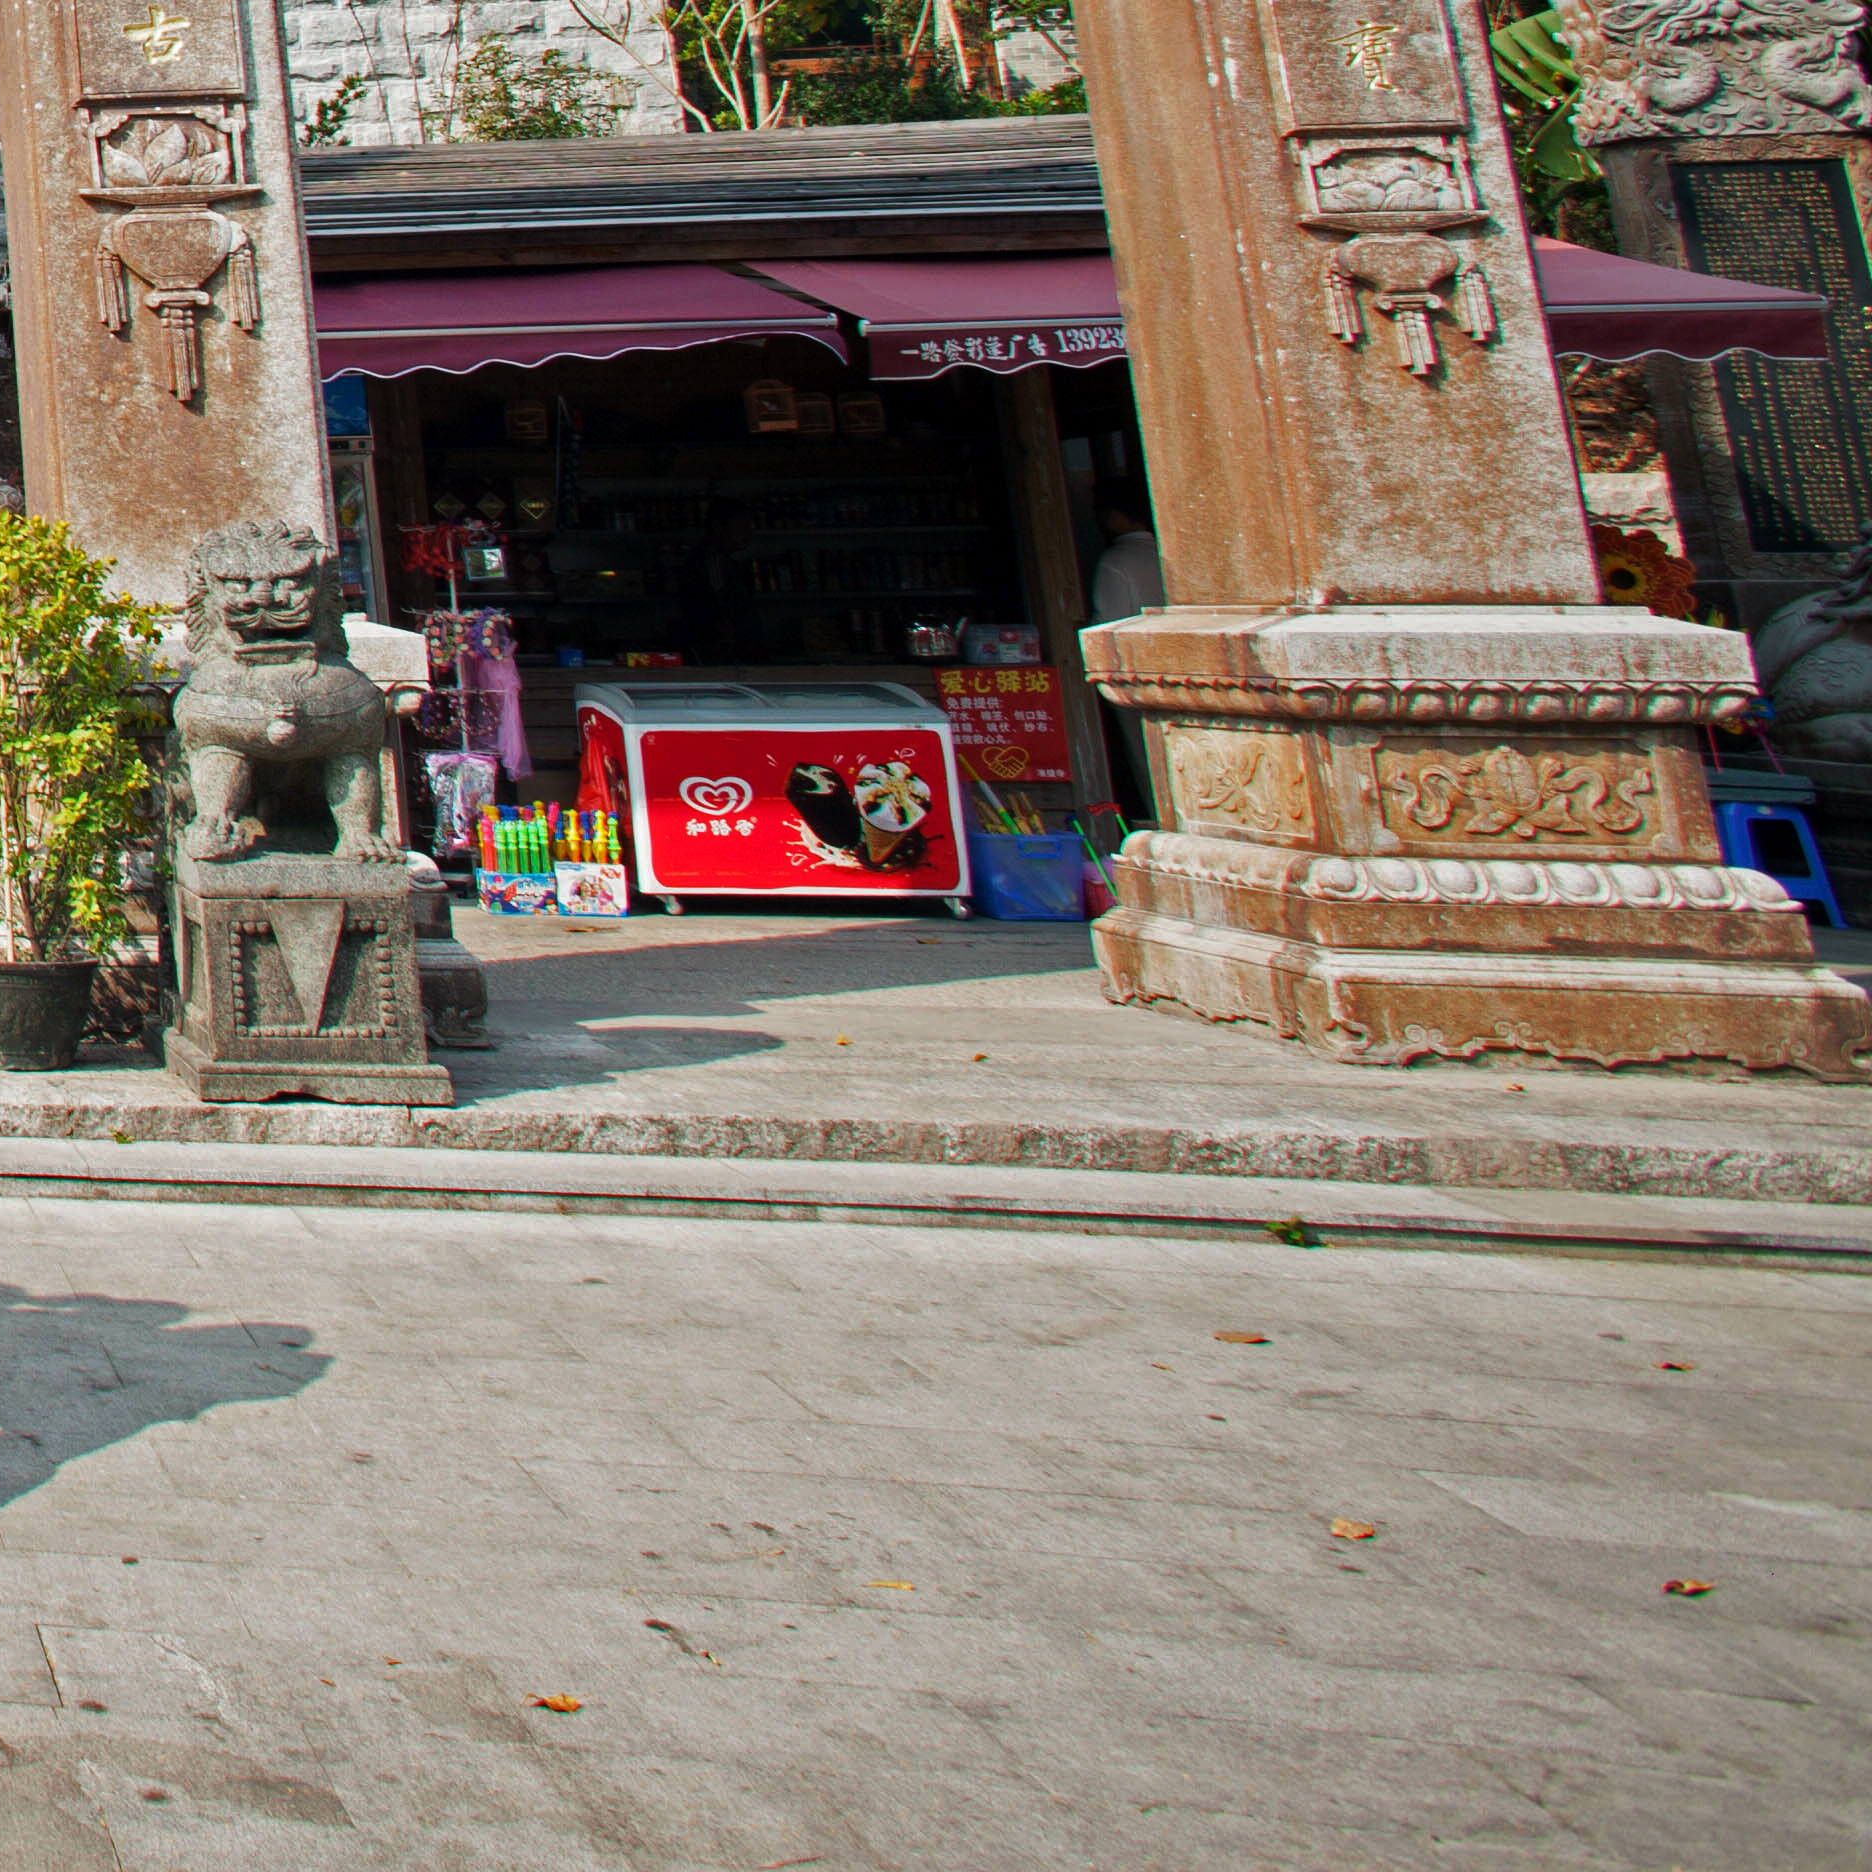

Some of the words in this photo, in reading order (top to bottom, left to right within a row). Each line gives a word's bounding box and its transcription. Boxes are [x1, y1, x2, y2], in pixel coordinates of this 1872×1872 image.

[941, 670, 1050, 694] 爱心驿站
[686, 818, 755, 836] 和路雪
